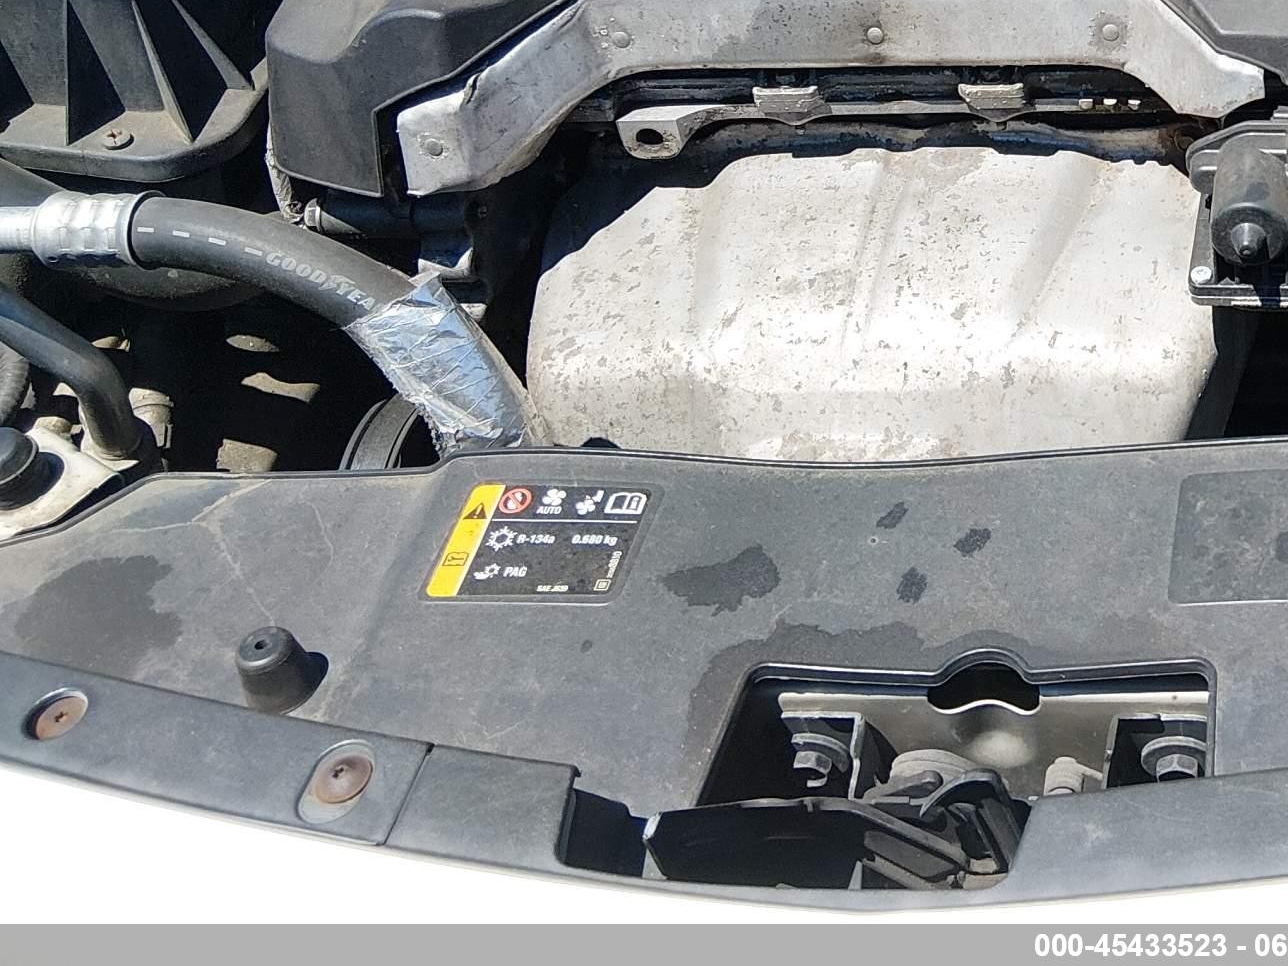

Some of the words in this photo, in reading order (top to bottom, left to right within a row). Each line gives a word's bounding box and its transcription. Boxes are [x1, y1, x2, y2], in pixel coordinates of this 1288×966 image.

[265, 252, 377, 311] GOODYEA
[536, 506, 562, 515] AUTO
[516, 534, 556, 544] R-134a
[571, 535, 602, 545] 0.680
[603, 535, 618, 547] kg
[502, 566, 528, 578] PAG
